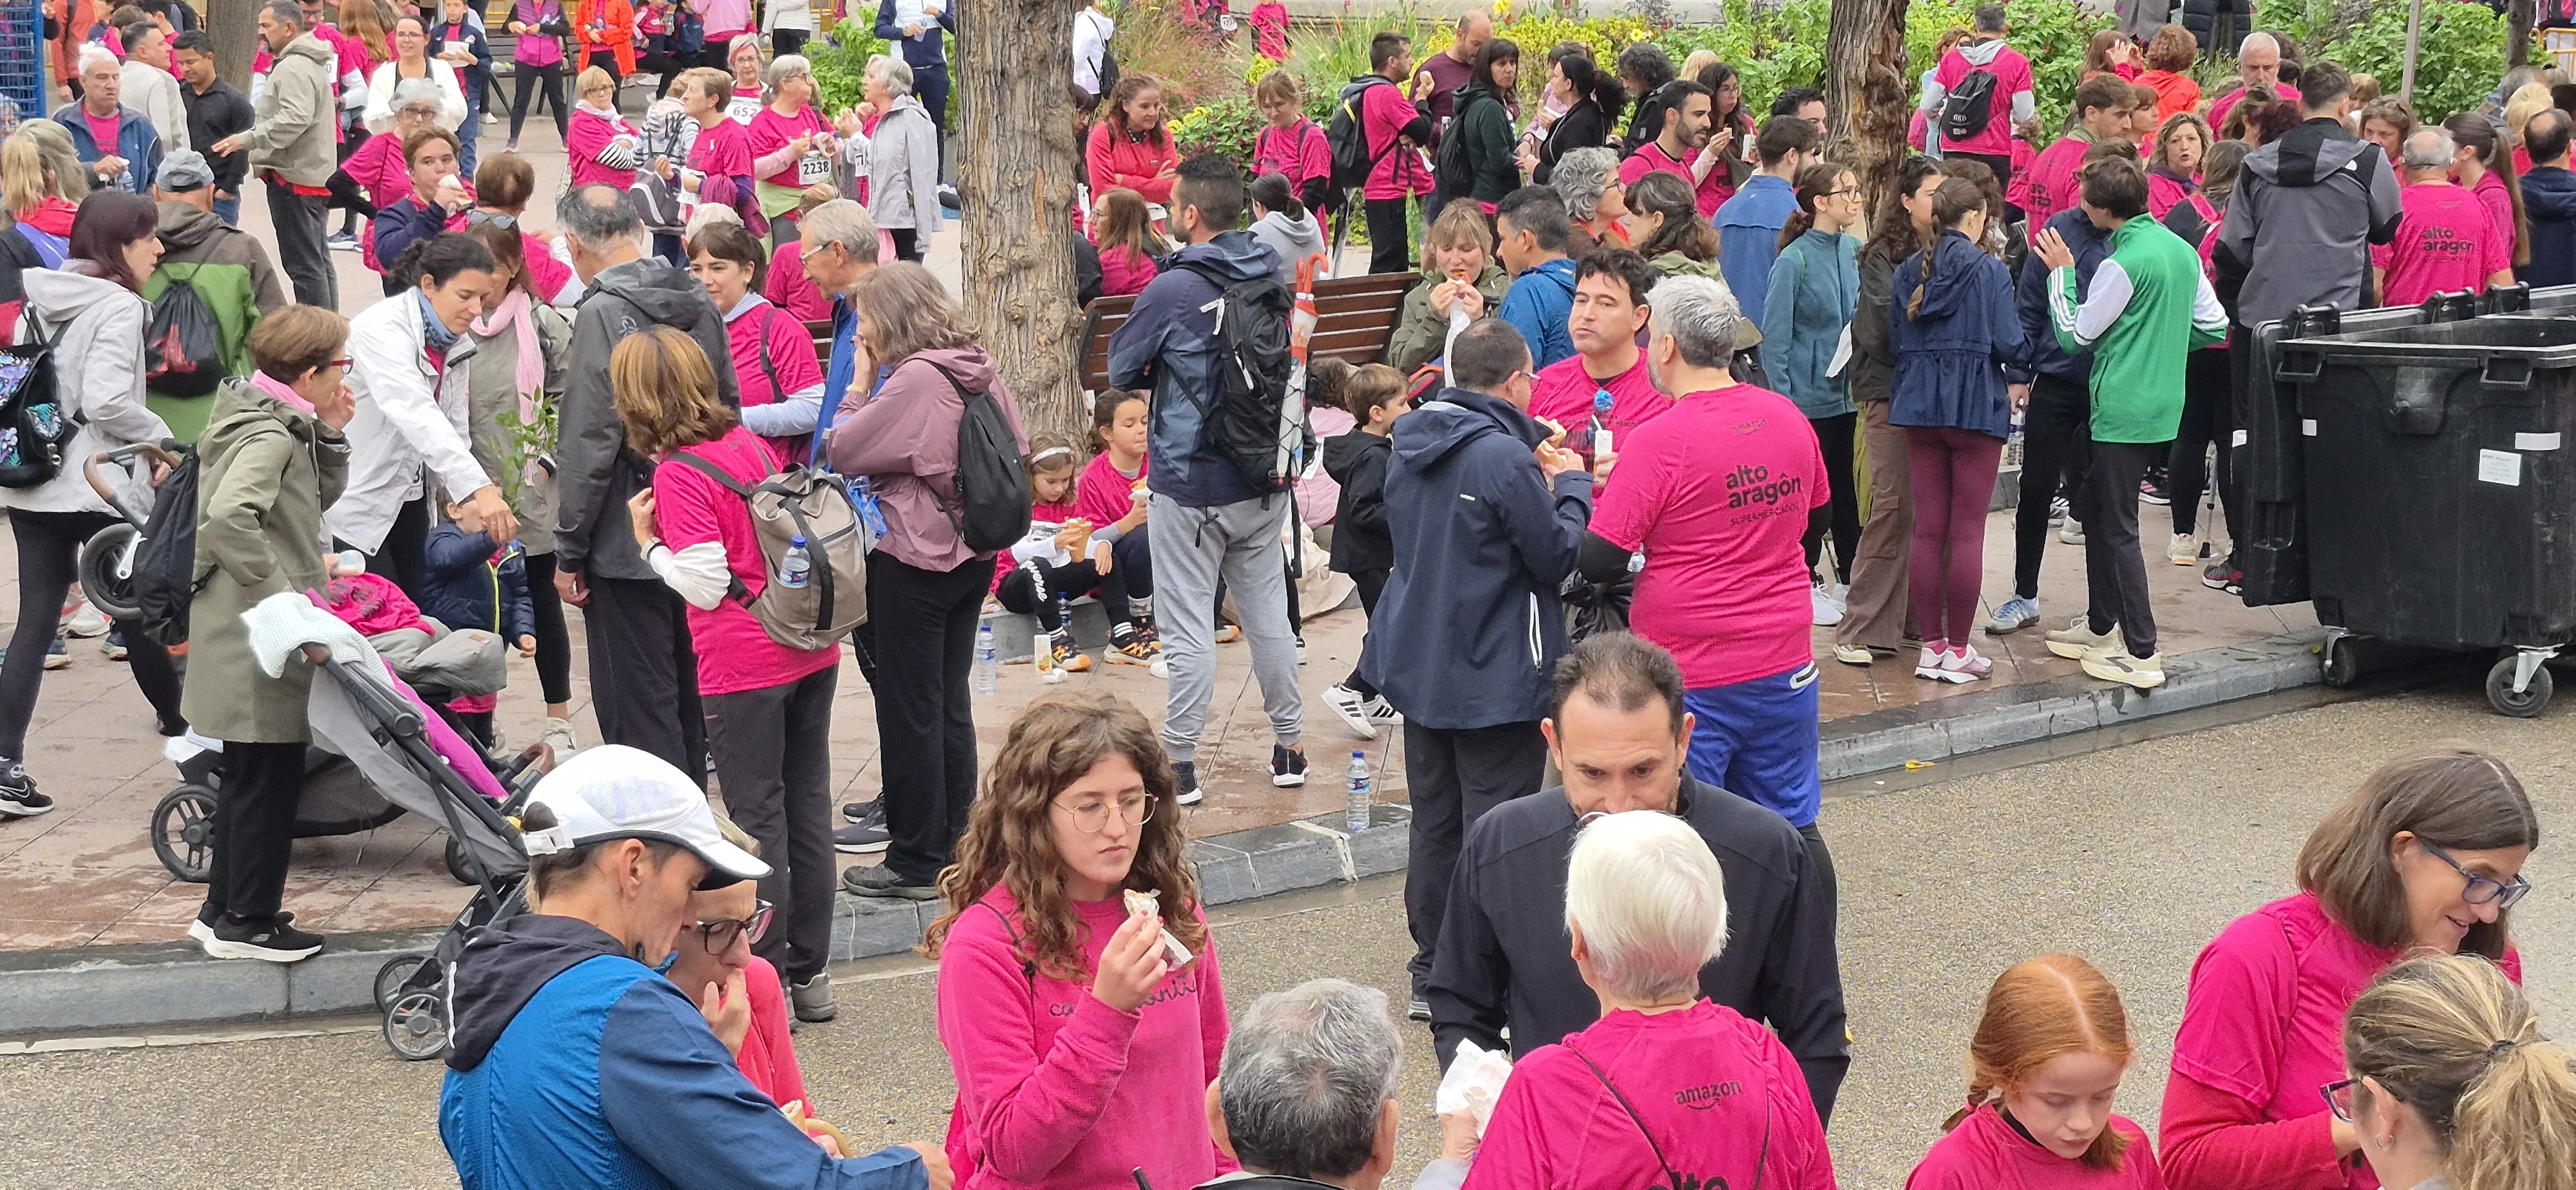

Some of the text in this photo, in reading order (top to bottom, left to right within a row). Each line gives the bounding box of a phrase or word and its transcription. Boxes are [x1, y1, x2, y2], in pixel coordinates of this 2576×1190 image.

[803, 160, 829, 175] 2238
[2423, 226, 2454, 239] alto
[1726, 464, 1768, 489] alto
[1675, 1081, 1741, 1105] amazon
